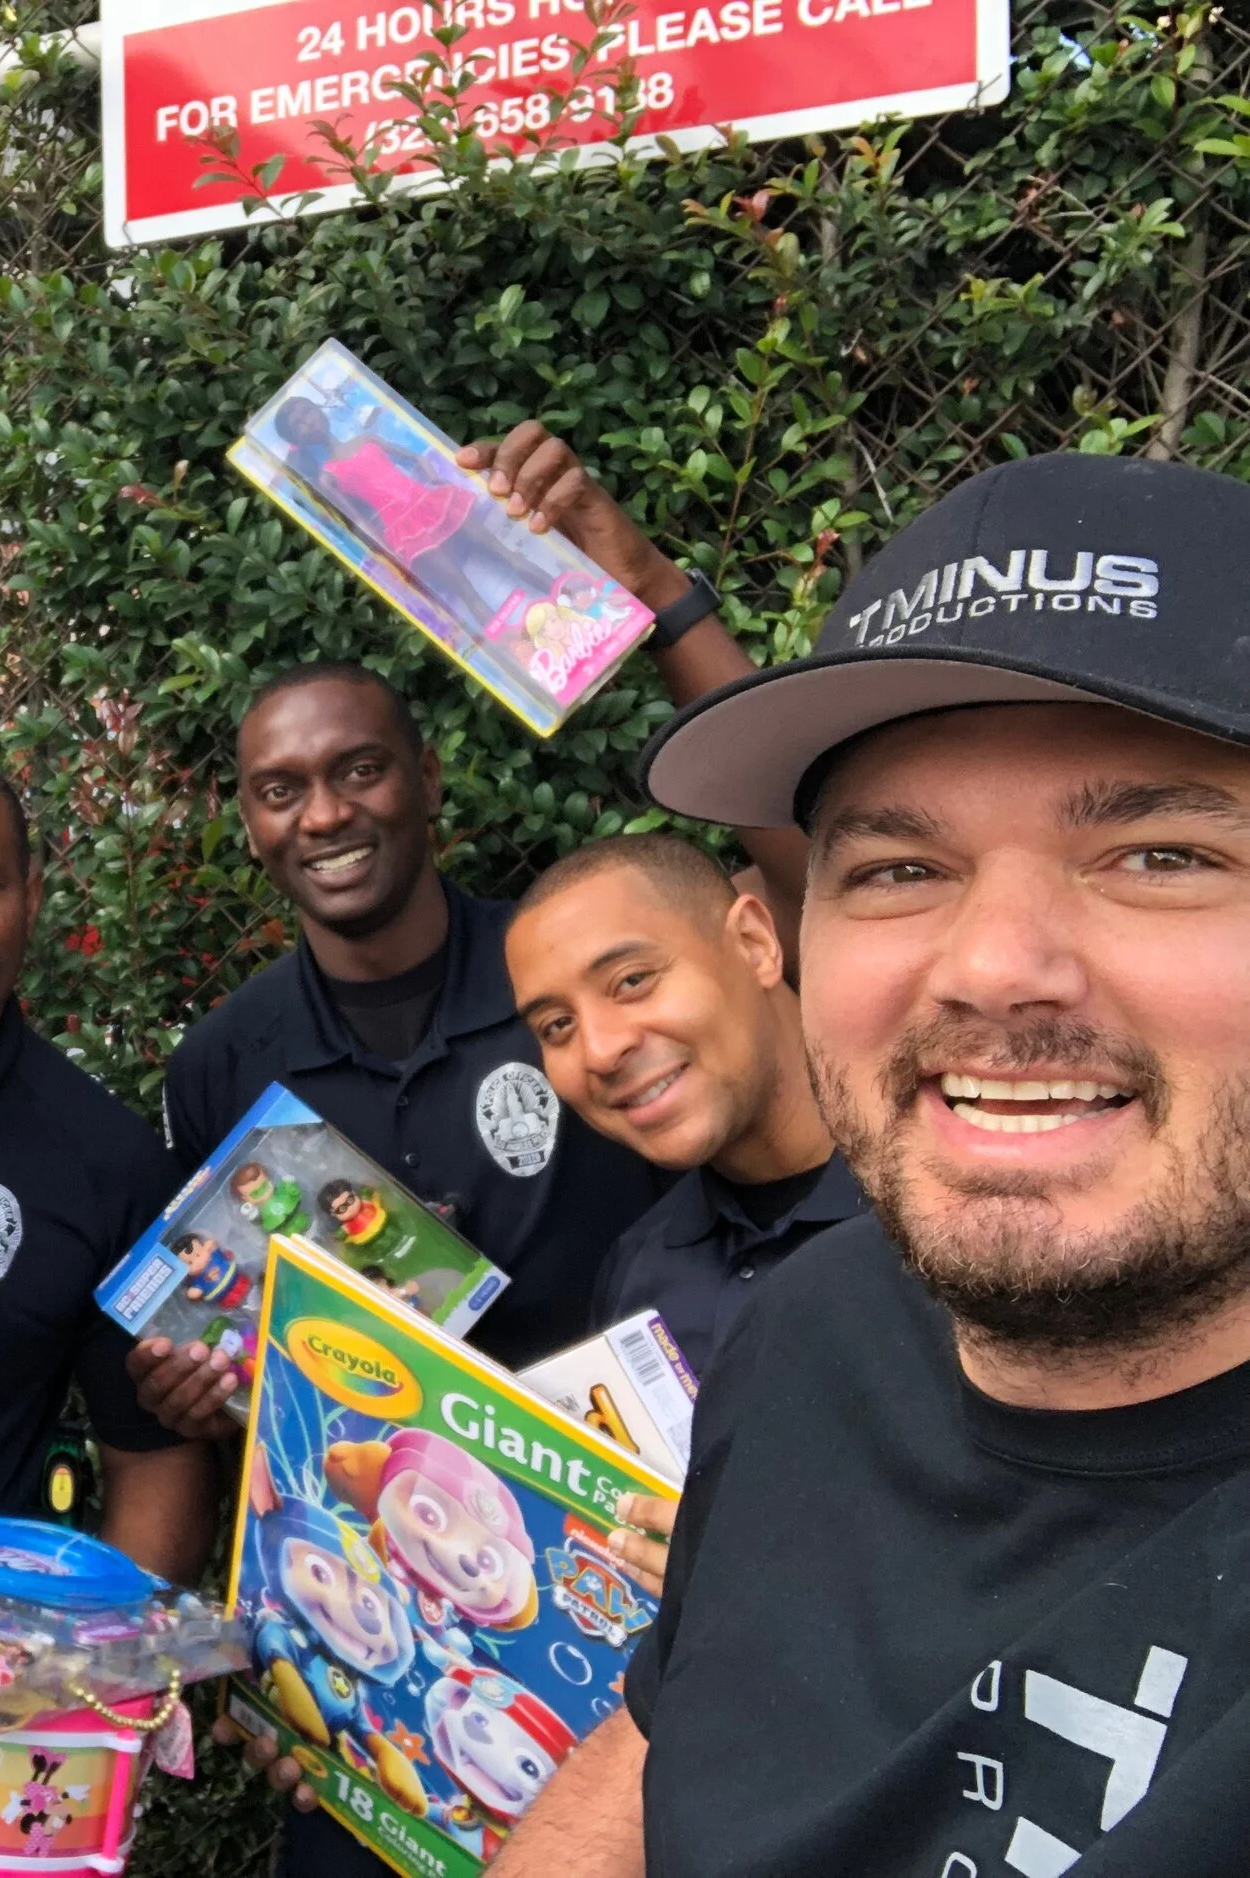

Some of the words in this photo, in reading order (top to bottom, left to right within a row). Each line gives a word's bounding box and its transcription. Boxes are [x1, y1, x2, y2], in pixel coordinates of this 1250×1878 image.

[297, 21, 345, 62] 24
[356, 0, 516, 51] HOURS
[156, 95, 238, 142] FOR
[595, 0, 784, 63] PLEASE
[858, 593, 1159, 649] RODUCTIONS
[529, 622, 612, 694] Barbie
[306, 1333, 398, 1387] Crayola
[650, 1322, 680, 1362] made
[440, 1392, 593, 1497] Giant
[545, 1547, 653, 1633] PAW
[562, 1592, 616, 1641] PATROL
[333, 1769, 376, 1823] 18
[379, 1811, 448, 1878] Giant
